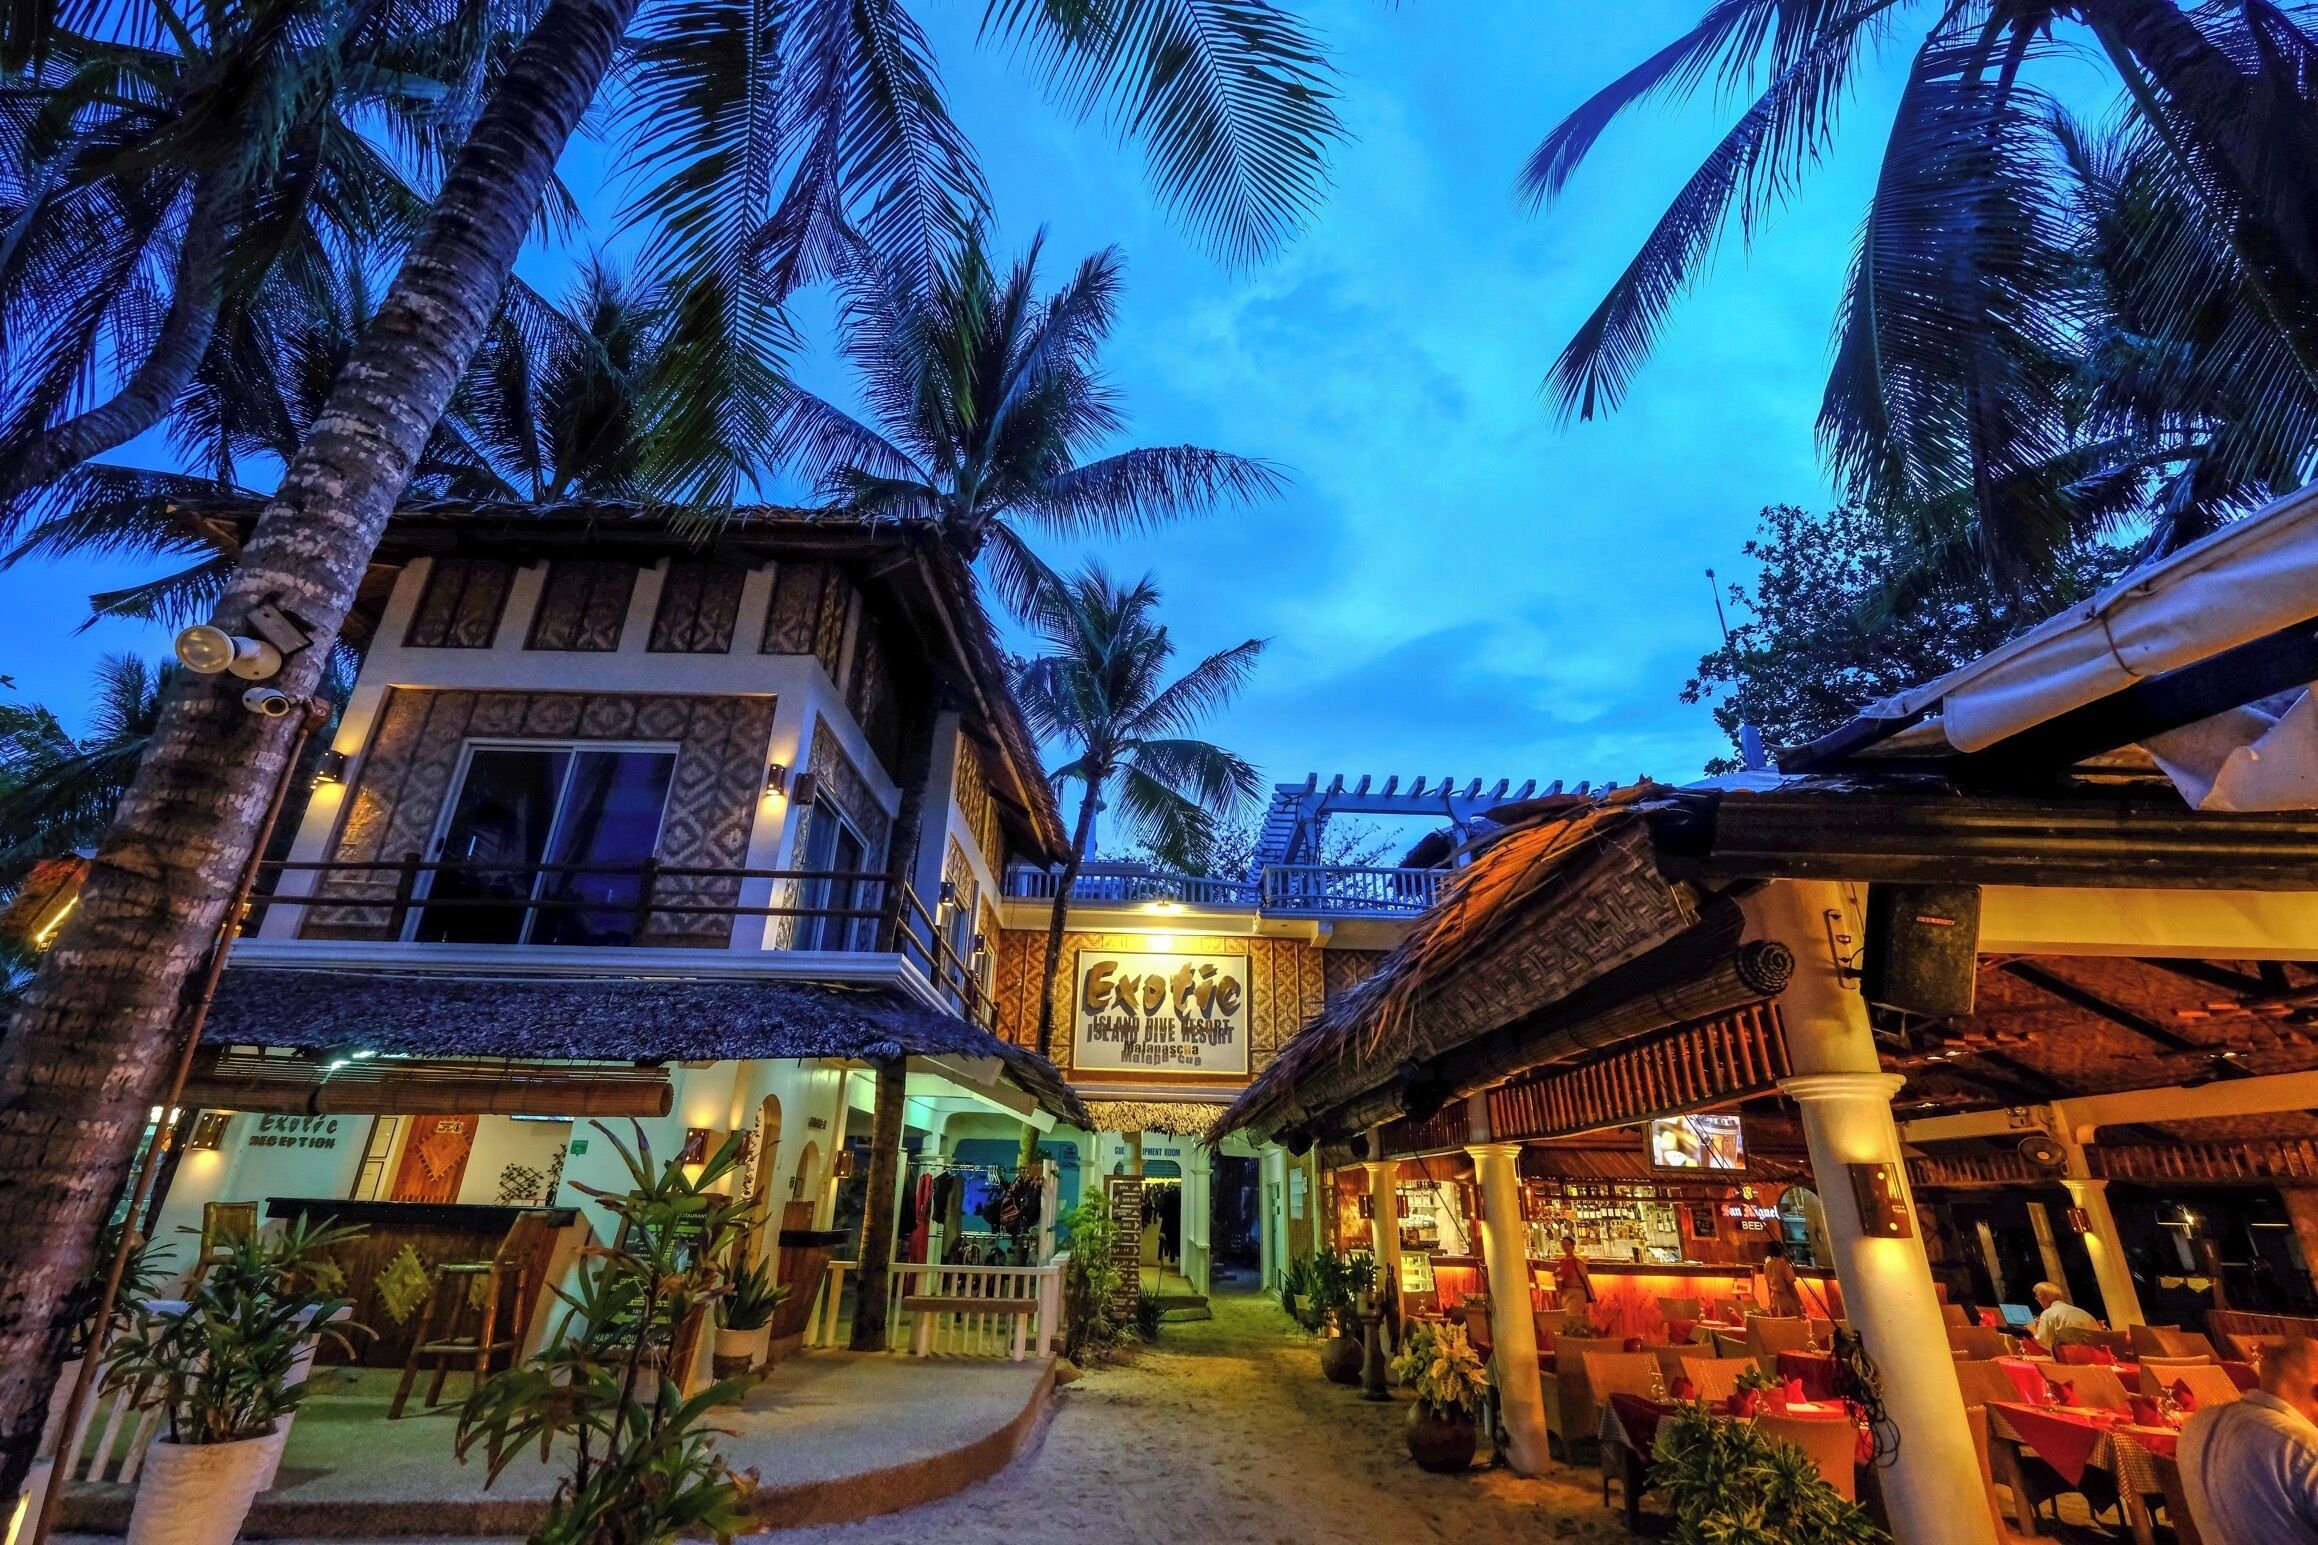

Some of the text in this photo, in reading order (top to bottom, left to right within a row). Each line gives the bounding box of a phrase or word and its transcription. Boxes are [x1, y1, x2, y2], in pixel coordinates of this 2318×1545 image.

[1083, 961, 1241, 1018] Exotic
[1088, 1016, 1233, 1042] ISLAND DIVE RESORT
[249, 1136, 336, 1149] RECEPTION
[1164, 1148, 1181, 1157] ROOM
[1721, 1203, 1780, 1220] San Miguel
